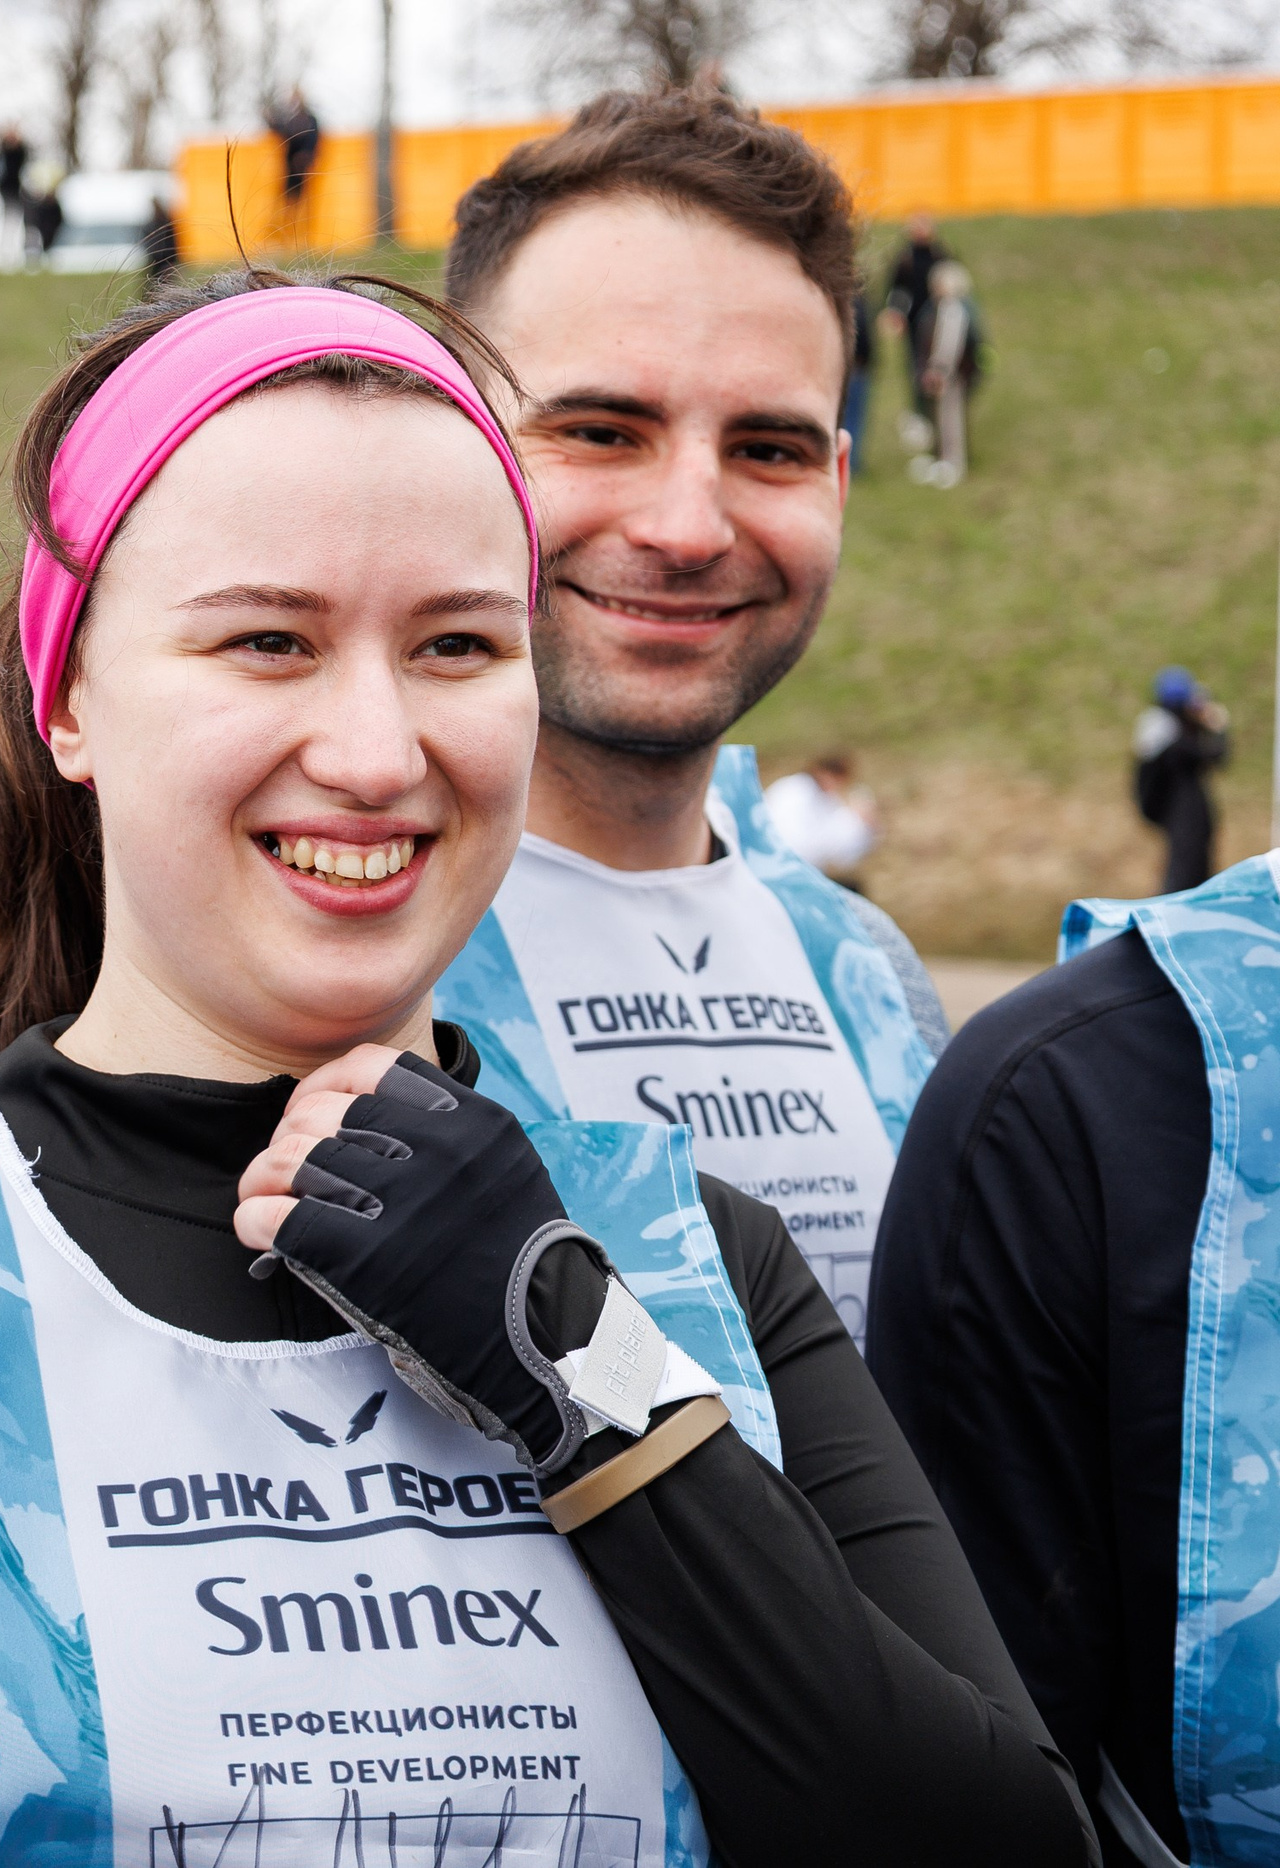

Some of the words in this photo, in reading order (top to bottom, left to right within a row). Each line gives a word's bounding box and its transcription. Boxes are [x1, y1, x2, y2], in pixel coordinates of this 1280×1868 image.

[558, 992, 698, 1036] ГОНКА
[699, 994, 826, 1034] ГЕРОЕВ
[636, 1075, 838, 1137] Sminex
[786, 1211, 866, 1233] OPMENT
[616, 1307, 647, 1373] planet
[97, 1473, 331, 1528] ГОНКА
[345, 1463, 545, 1518] ГЕРОЕ
[195, 1573, 559, 1655] Sminex
[220, 1704, 578, 1738] ПЕРФЕКЦИОНИСТЫ
[228, 1762, 312, 1787] FINE
[331, 1755, 581, 1785] DEVELOPMENT
